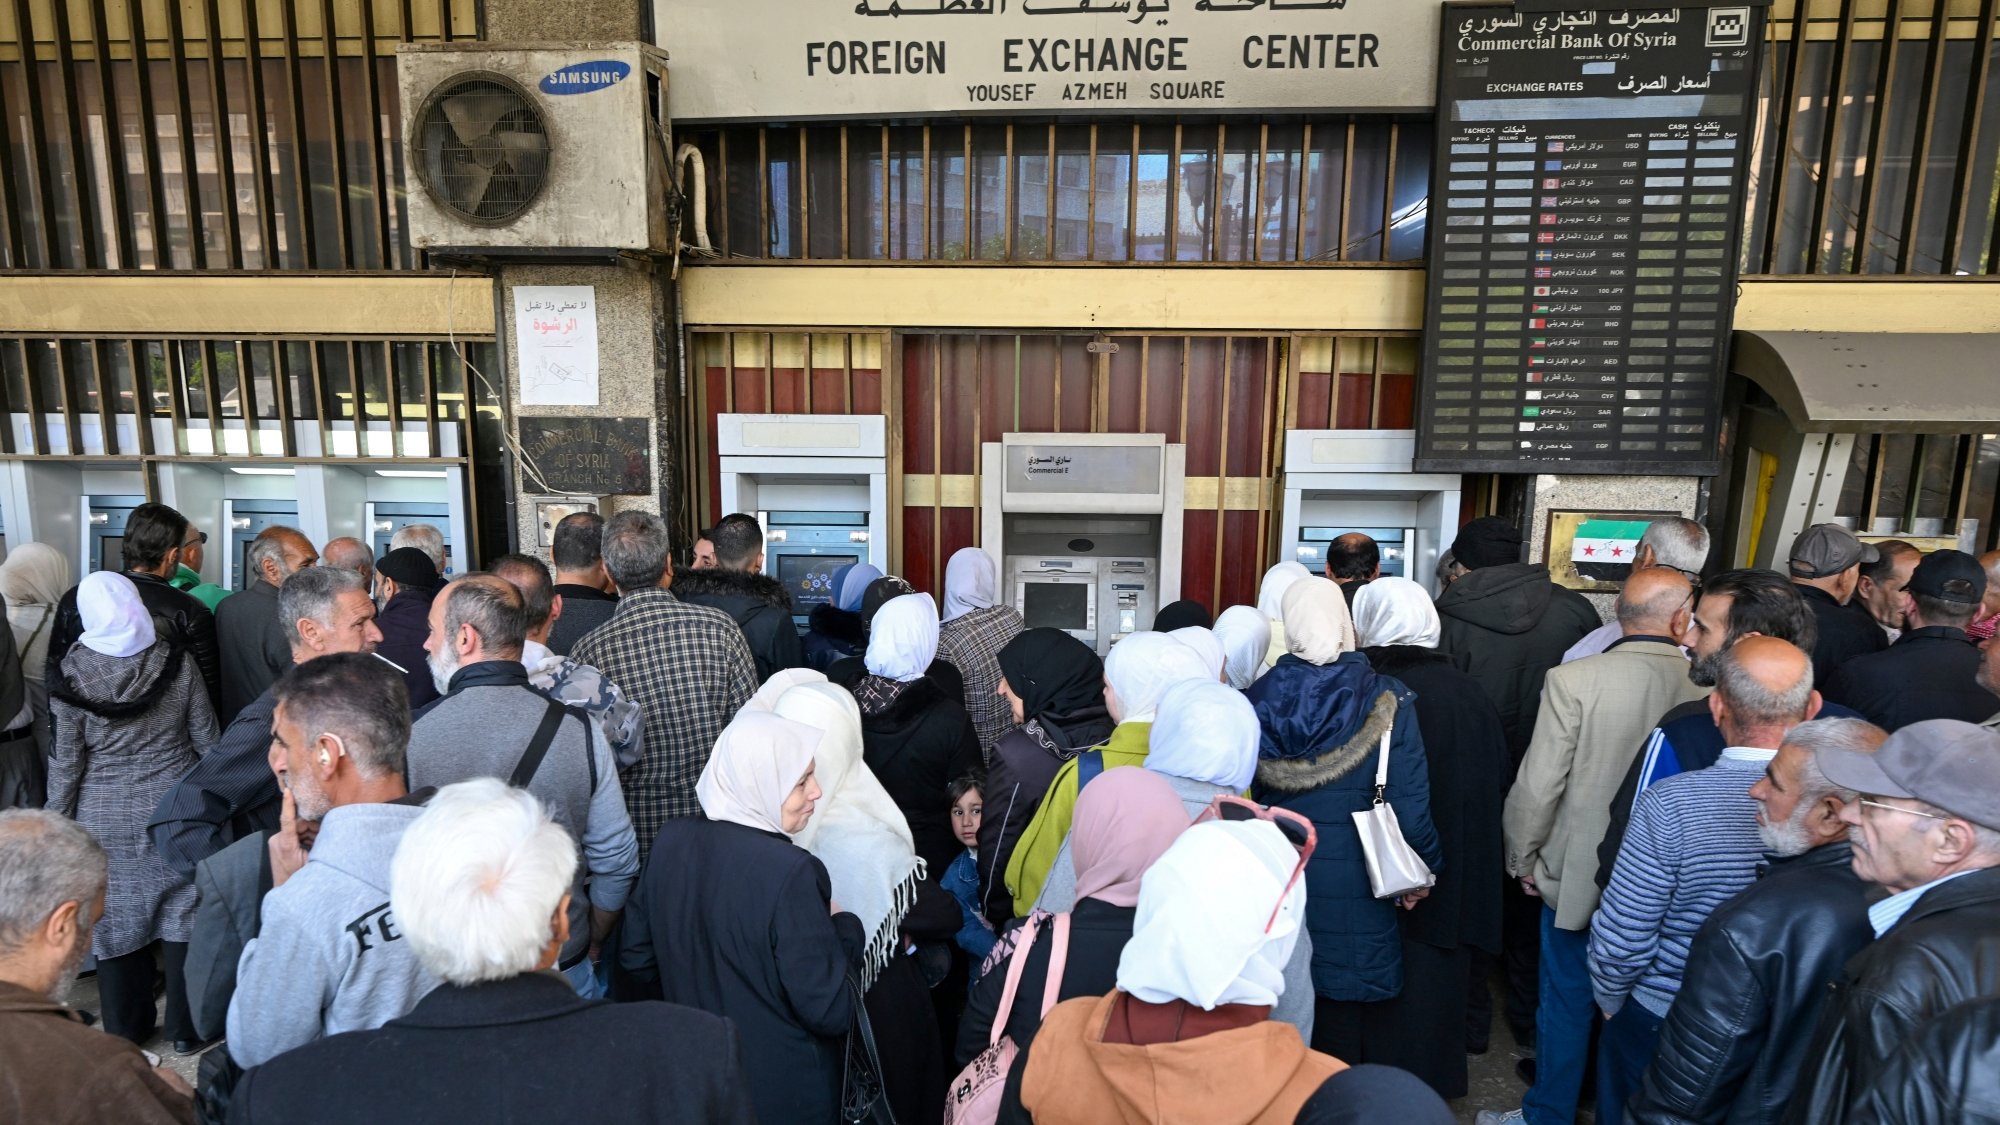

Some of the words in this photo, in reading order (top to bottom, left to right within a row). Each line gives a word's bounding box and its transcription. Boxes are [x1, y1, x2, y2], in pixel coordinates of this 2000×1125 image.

[1458, 12, 1523, 37] السوري
[1533, 10, 1597, 35] التجاري
[1608, 8, 1680, 29] المصرف
[1457, 34, 1556, 51] Commercial
[1560, 33, 1604, 49] Bank
[1608, 32, 1632, 48] Of
[1633, 31, 1677, 51] Syria
[806, 40, 946, 76] FOREIGN
[1003, 37, 1189, 73] EXCHANGE
[1242, 33, 1380, 69] CENTER
[550, 71, 620, 84] SAMSUNG
[1671, 71, 1711, 93] أسعار
[966, 83, 1037, 101] YOUSEF
[1062, 81, 1127, 100] AZMEH
[1149, 80, 1226, 100] SQUARE
[1486, 82, 1546, 93] EXCHANGE
[1547, 81, 1584, 92] RATES
[1617, 75, 1667, 94] الصرف
[1674, 130, 1690, 138] شراء
[1587, 142, 1604, 150] دولار
[1560, 179, 1576, 188] كندي
[1577, 179, 1594, 187] دولار
[525, 300, 542, 312] تقبل
[545, 300, 555, 311] ولا
[557, 300, 577, 315] تعطي
[579, 300, 587, 310] لا
[1568, 304, 1582, 312] دينار
[533, 316, 577, 335] الرشوة
[1569, 319, 1585, 328] دينار
[1566, 338, 1581, 346] دينار
[1540, 408, 1562, 416] سعودي
[529, 427, 601, 460] COMMERCIAL
[558, 453, 573, 468] OF
[576, 453, 611, 469] SYRIA
[1028, 456, 1055, 466] السوري
[1028, 466, 1064, 474] Commercial
[548, 474, 592, 484] BRANCH
